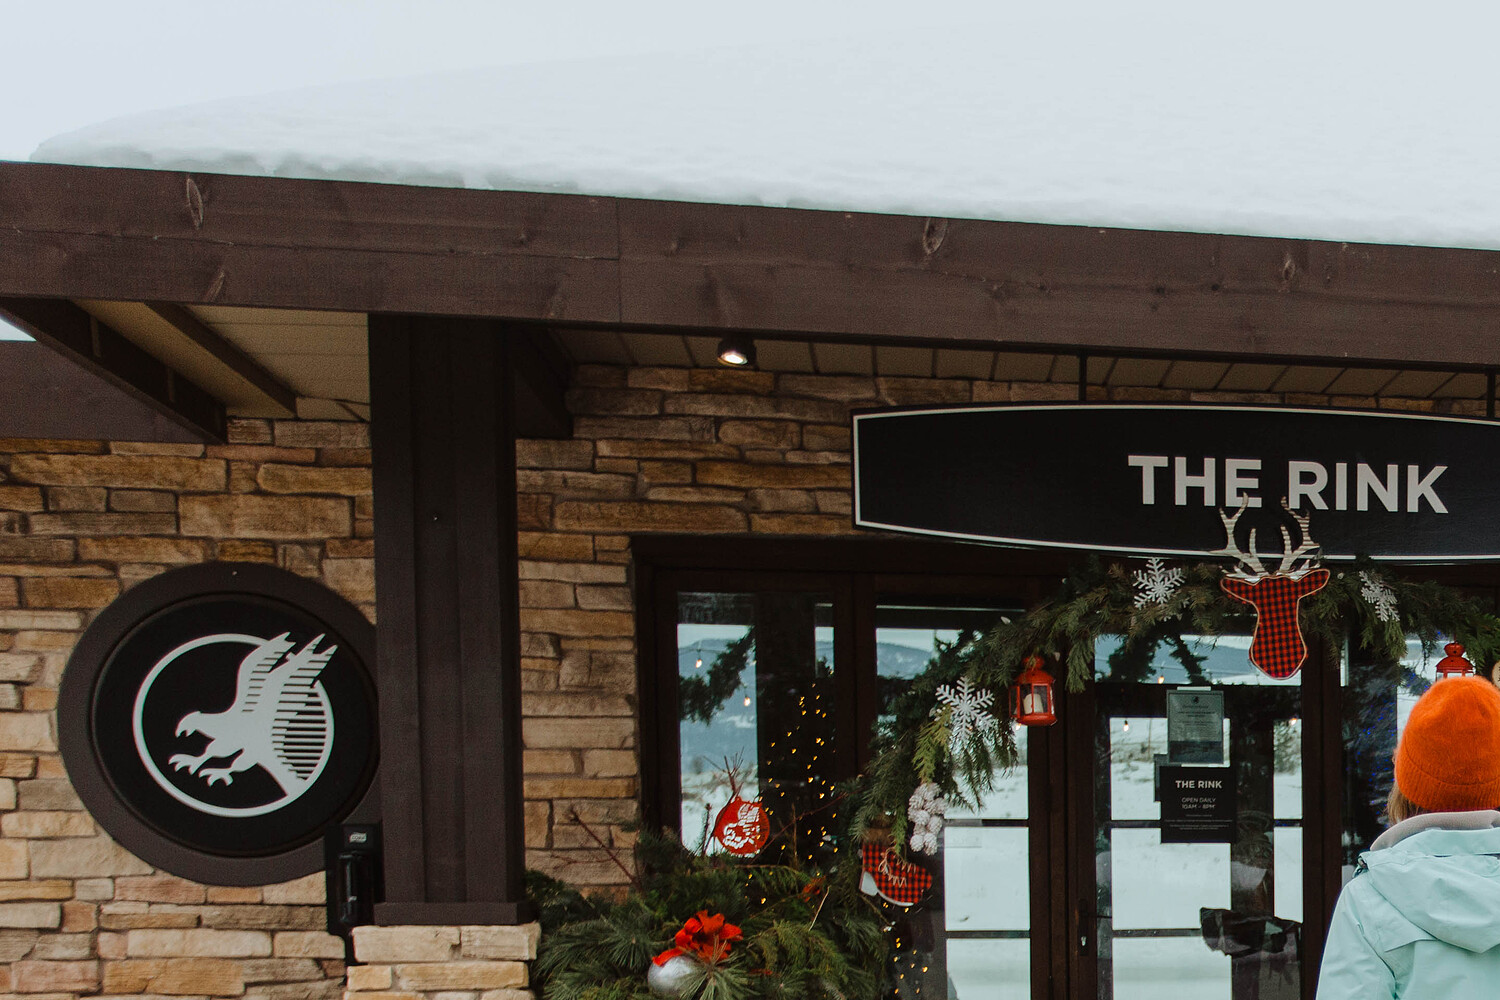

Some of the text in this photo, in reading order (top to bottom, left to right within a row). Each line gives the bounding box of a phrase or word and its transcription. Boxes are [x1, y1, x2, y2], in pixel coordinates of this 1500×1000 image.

[1128, 455, 1449, 515] THE RINK
[1175, 780, 1222, 789] THE RINK
